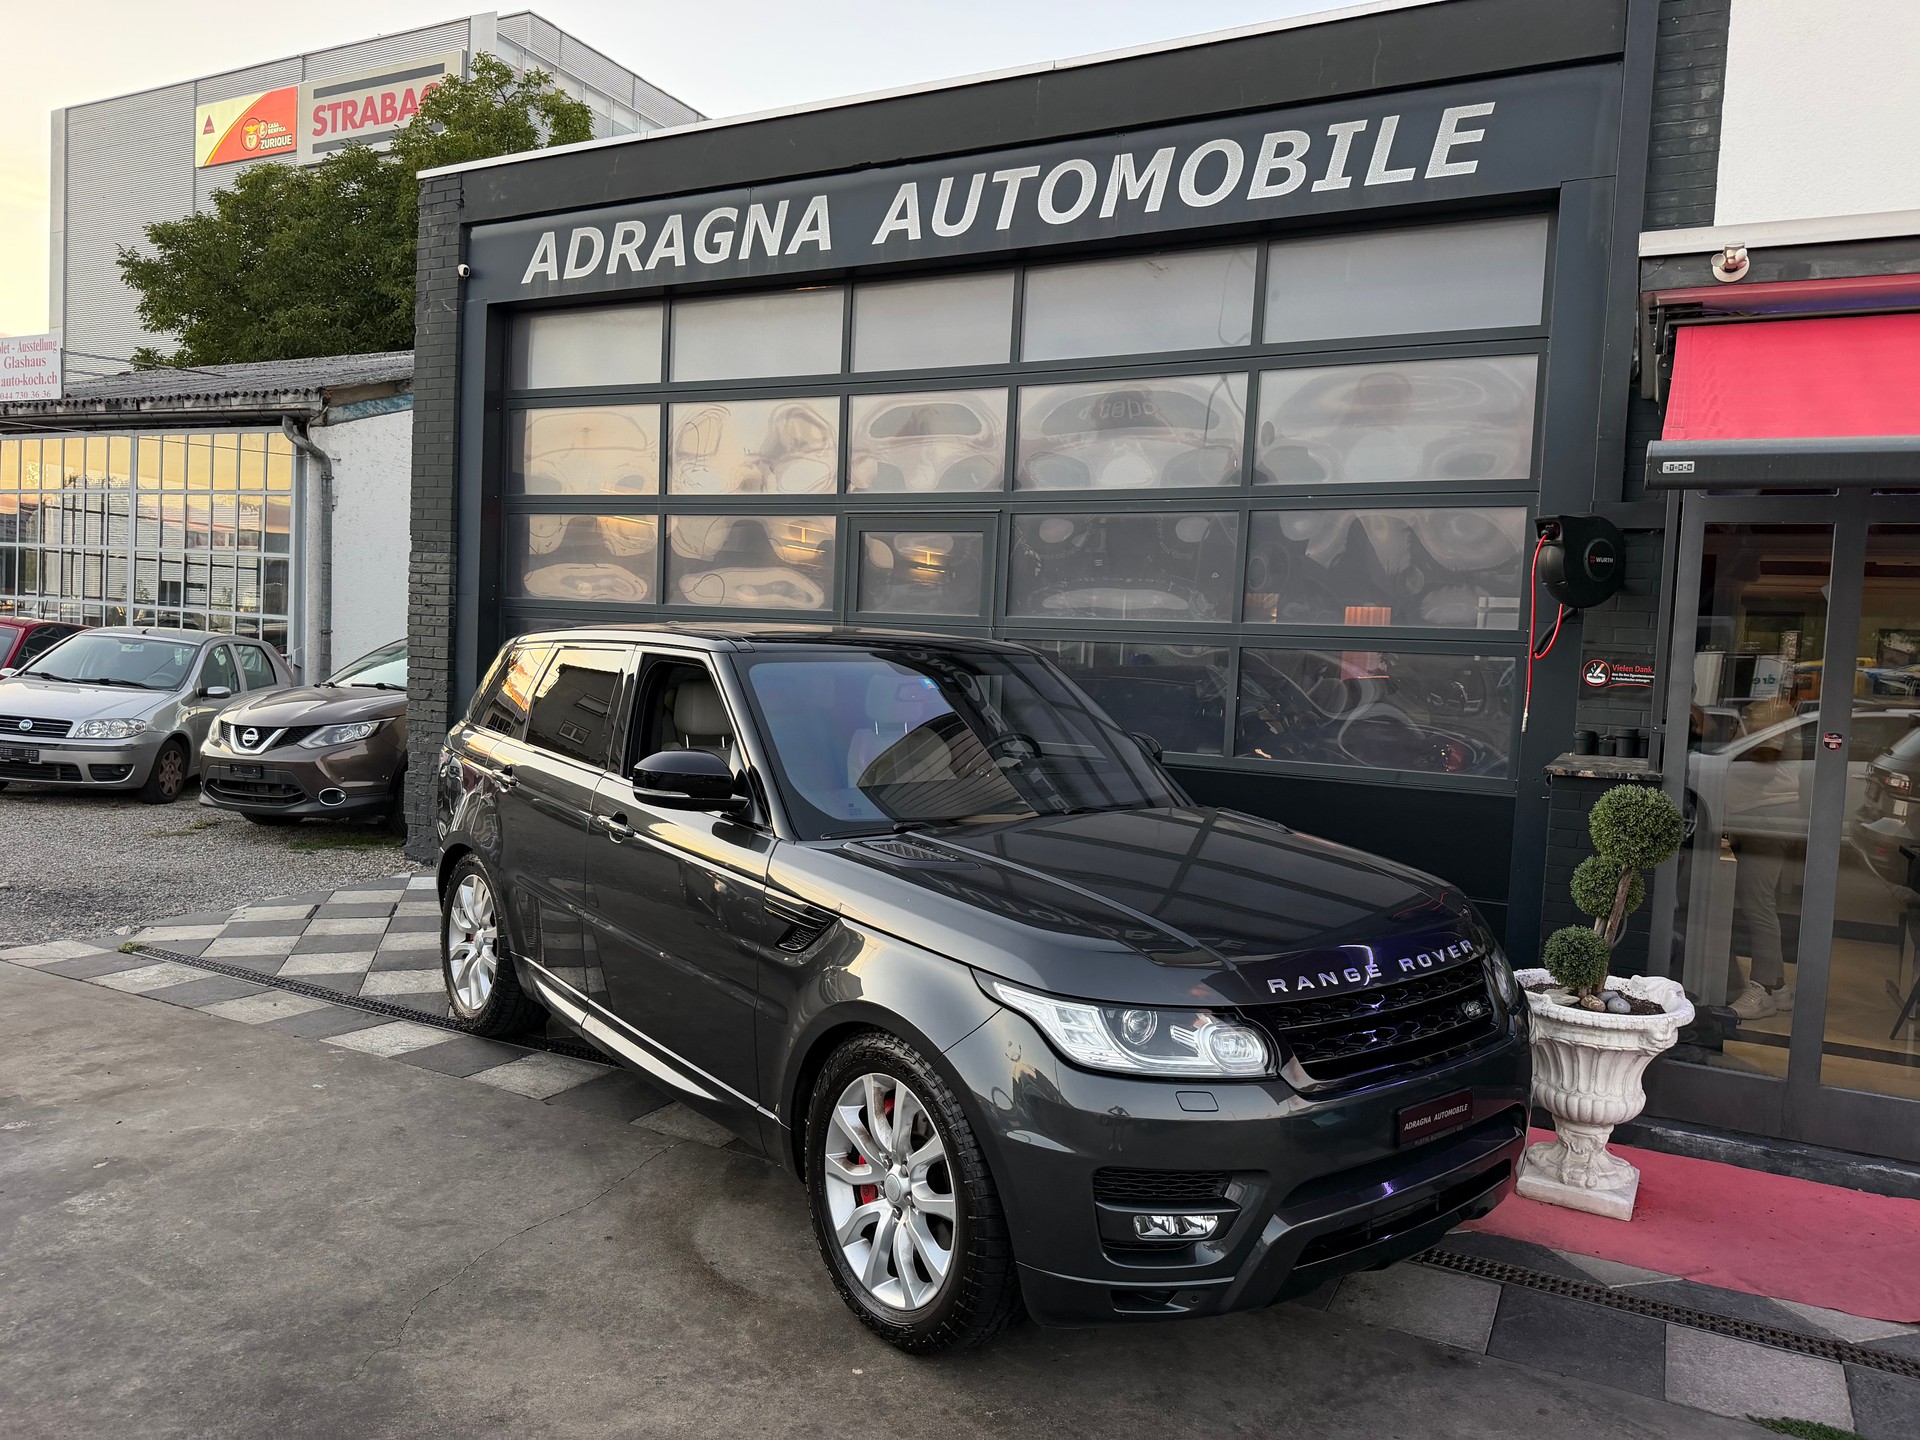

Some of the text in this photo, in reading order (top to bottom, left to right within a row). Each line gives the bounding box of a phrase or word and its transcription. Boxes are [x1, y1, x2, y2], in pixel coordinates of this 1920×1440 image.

[260, 135, 292, 150] ZURIQUE
[520, 102, 1496, 285] ADRAGNA AUTOMOBILE
[17, 338, 57, 353] Ausstellung
[4, 355, 47, 369] Glashaus
[15, 391, 28, 399] 730
[30, 390, 39, 398] 36
[42, 390, 51, 398] 36
[1612, 664, 1633, 672] Vielen
[1267, 939, 1474, 993] RANGE ROVER
[1404, 1104, 1468, 1130] ADRAGNA AUTOMOBILE
